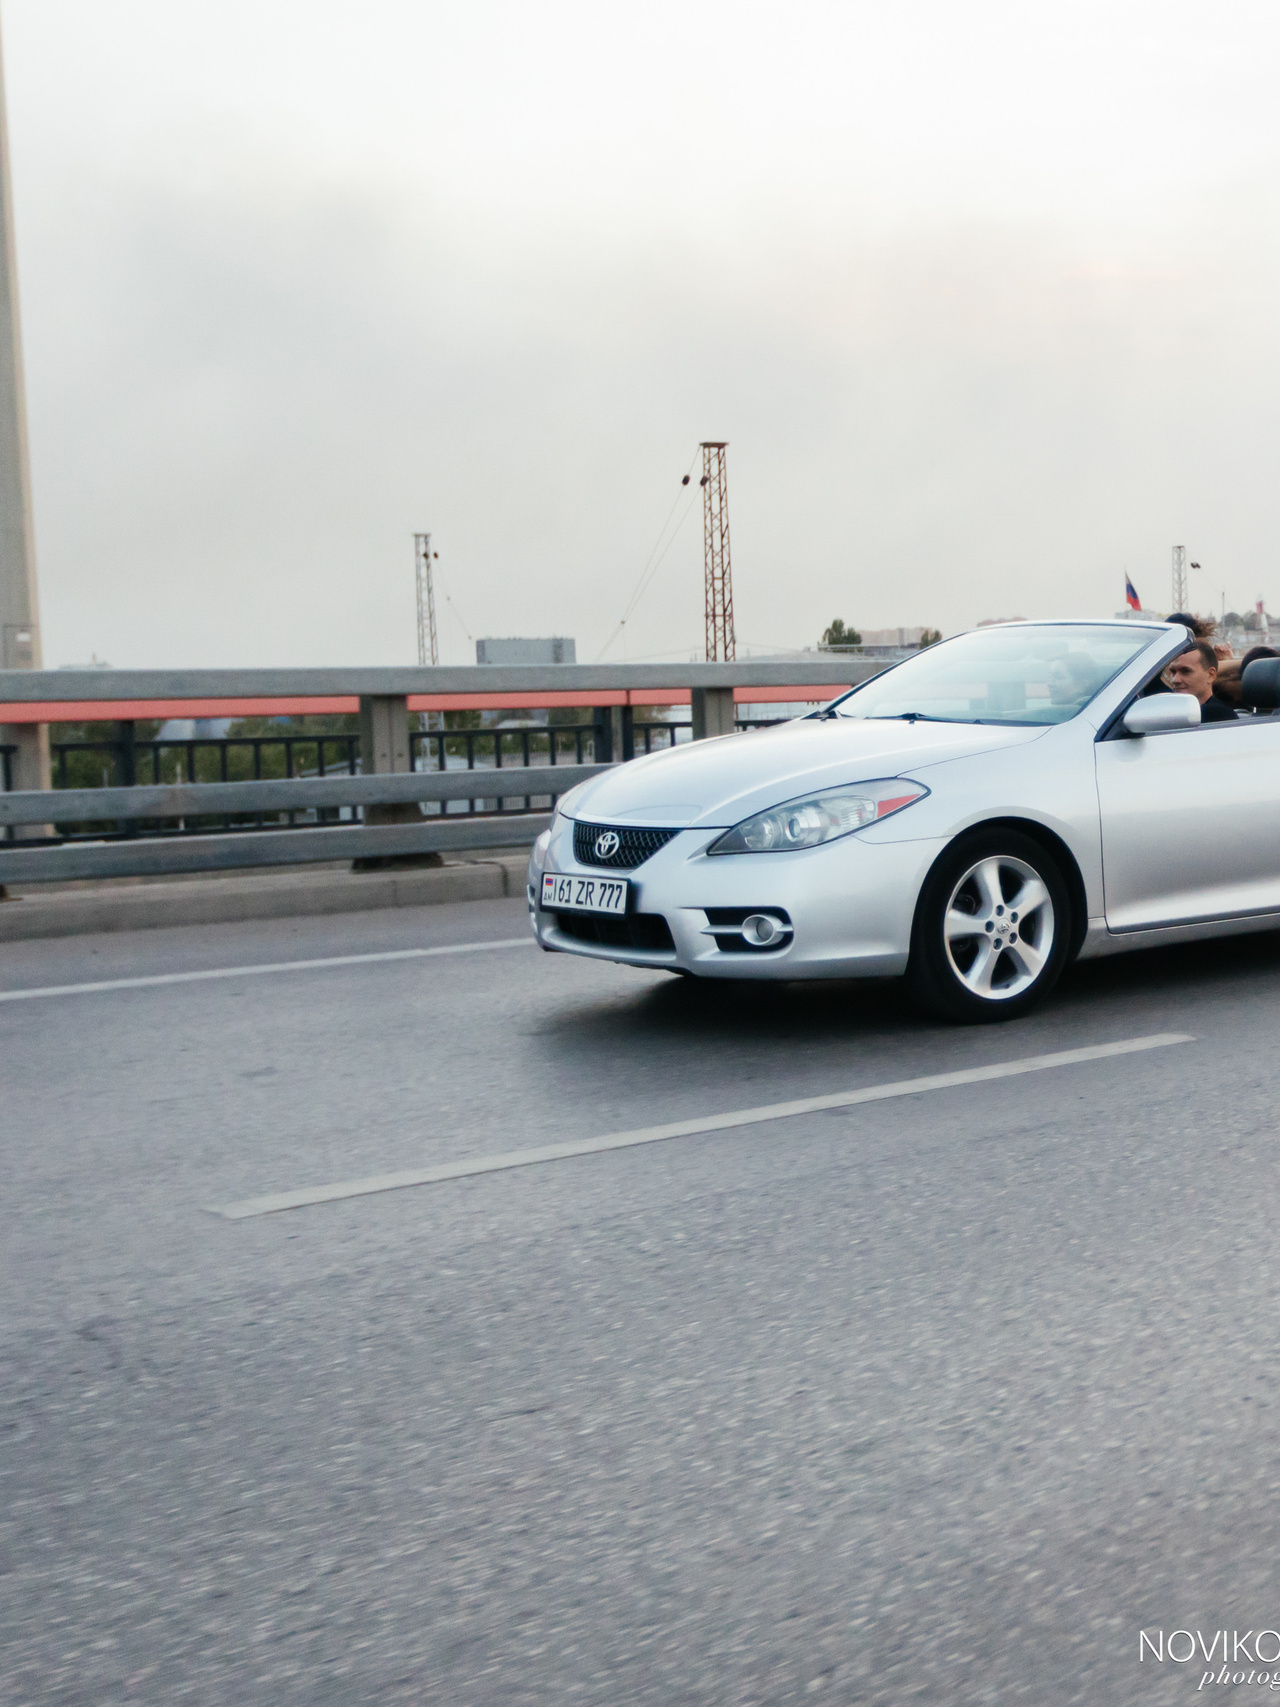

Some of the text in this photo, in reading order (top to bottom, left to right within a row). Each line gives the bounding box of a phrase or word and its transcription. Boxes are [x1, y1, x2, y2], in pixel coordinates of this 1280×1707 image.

[558, 879, 623, 908] 61 ZR 777
